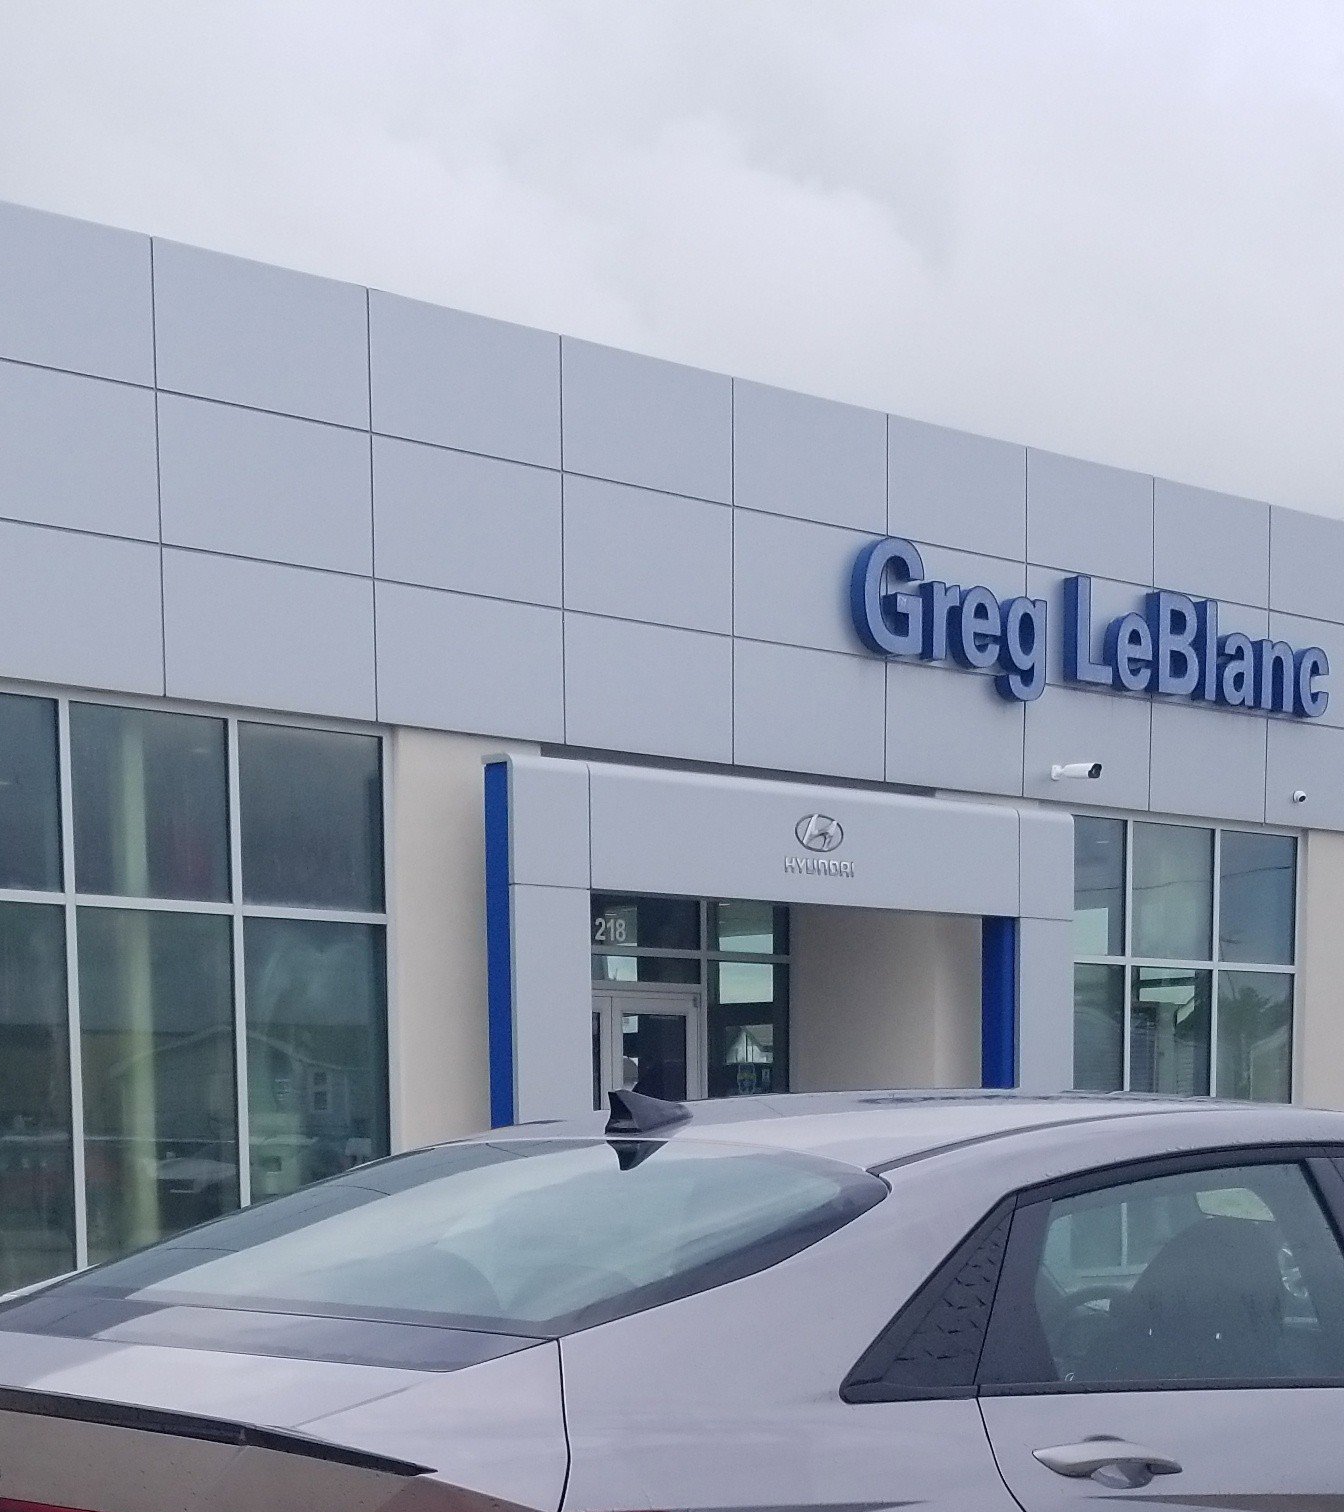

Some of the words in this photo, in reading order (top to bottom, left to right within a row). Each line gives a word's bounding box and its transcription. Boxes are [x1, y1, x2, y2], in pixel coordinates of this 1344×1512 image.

[852, 537, 1047, 702] Greg
[1063, 575, 1330, 718] LeBlanc
[784, 856, 855, 878] HYUNDAI
[594, 917, 626, 942] 218
